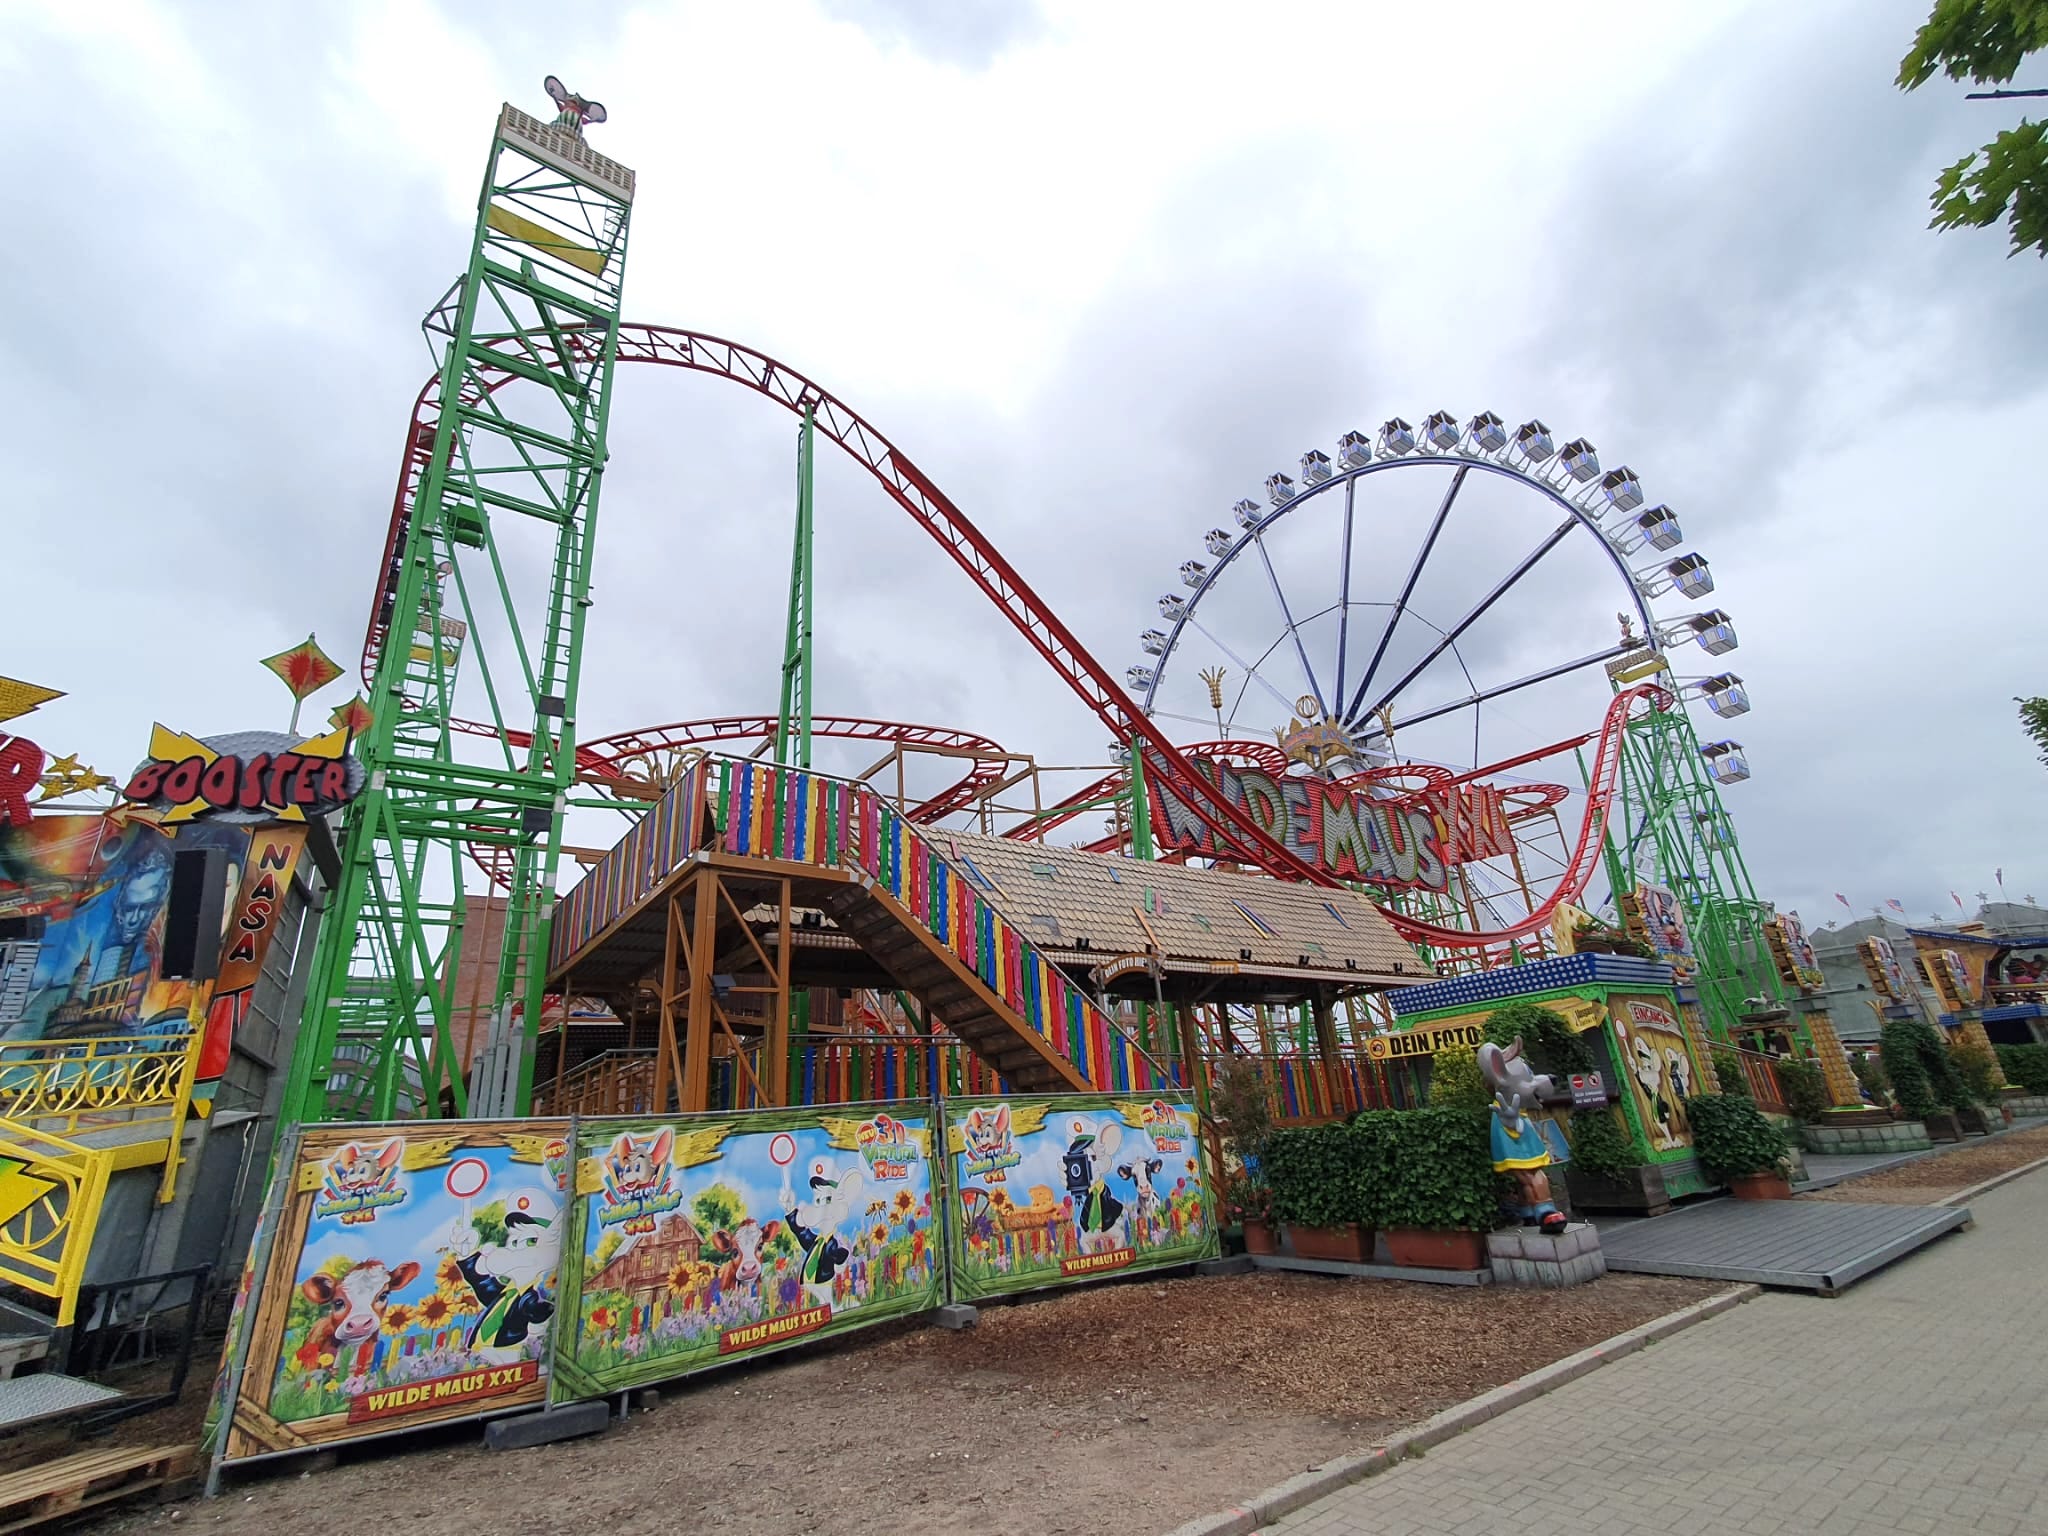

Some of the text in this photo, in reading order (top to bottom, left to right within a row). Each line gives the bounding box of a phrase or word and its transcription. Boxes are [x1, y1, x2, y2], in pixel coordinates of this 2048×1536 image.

[123, 753, 350, 809] BOOSTER
[1321, 790, 1445, 889] MAUS
[1424, 783, 1518, 866] XXL
[228, 842, 292, 963] NASA
[1118, 957, 1134, 970] FOTO
[1633, 1007, 1663, 1023] EINGANG
[1389, 1026, 1480, 1056] DEIN FOTO
[1145, 1124, 1187, 1142] VIRTUAL
[1155, 1137, 1182, 1152] RIDE
[860, 1143, 918, 1168] VIRTUAL
[873, 1159, 908, 1179] RIDE
[1065, 1250, 1129, 1271] WILDE MAUS XXL
[728, 1310, 823, 1346] WILDE MAUS XXL
[367, 1367, 524, 1412] WILDE MAUS XXL
